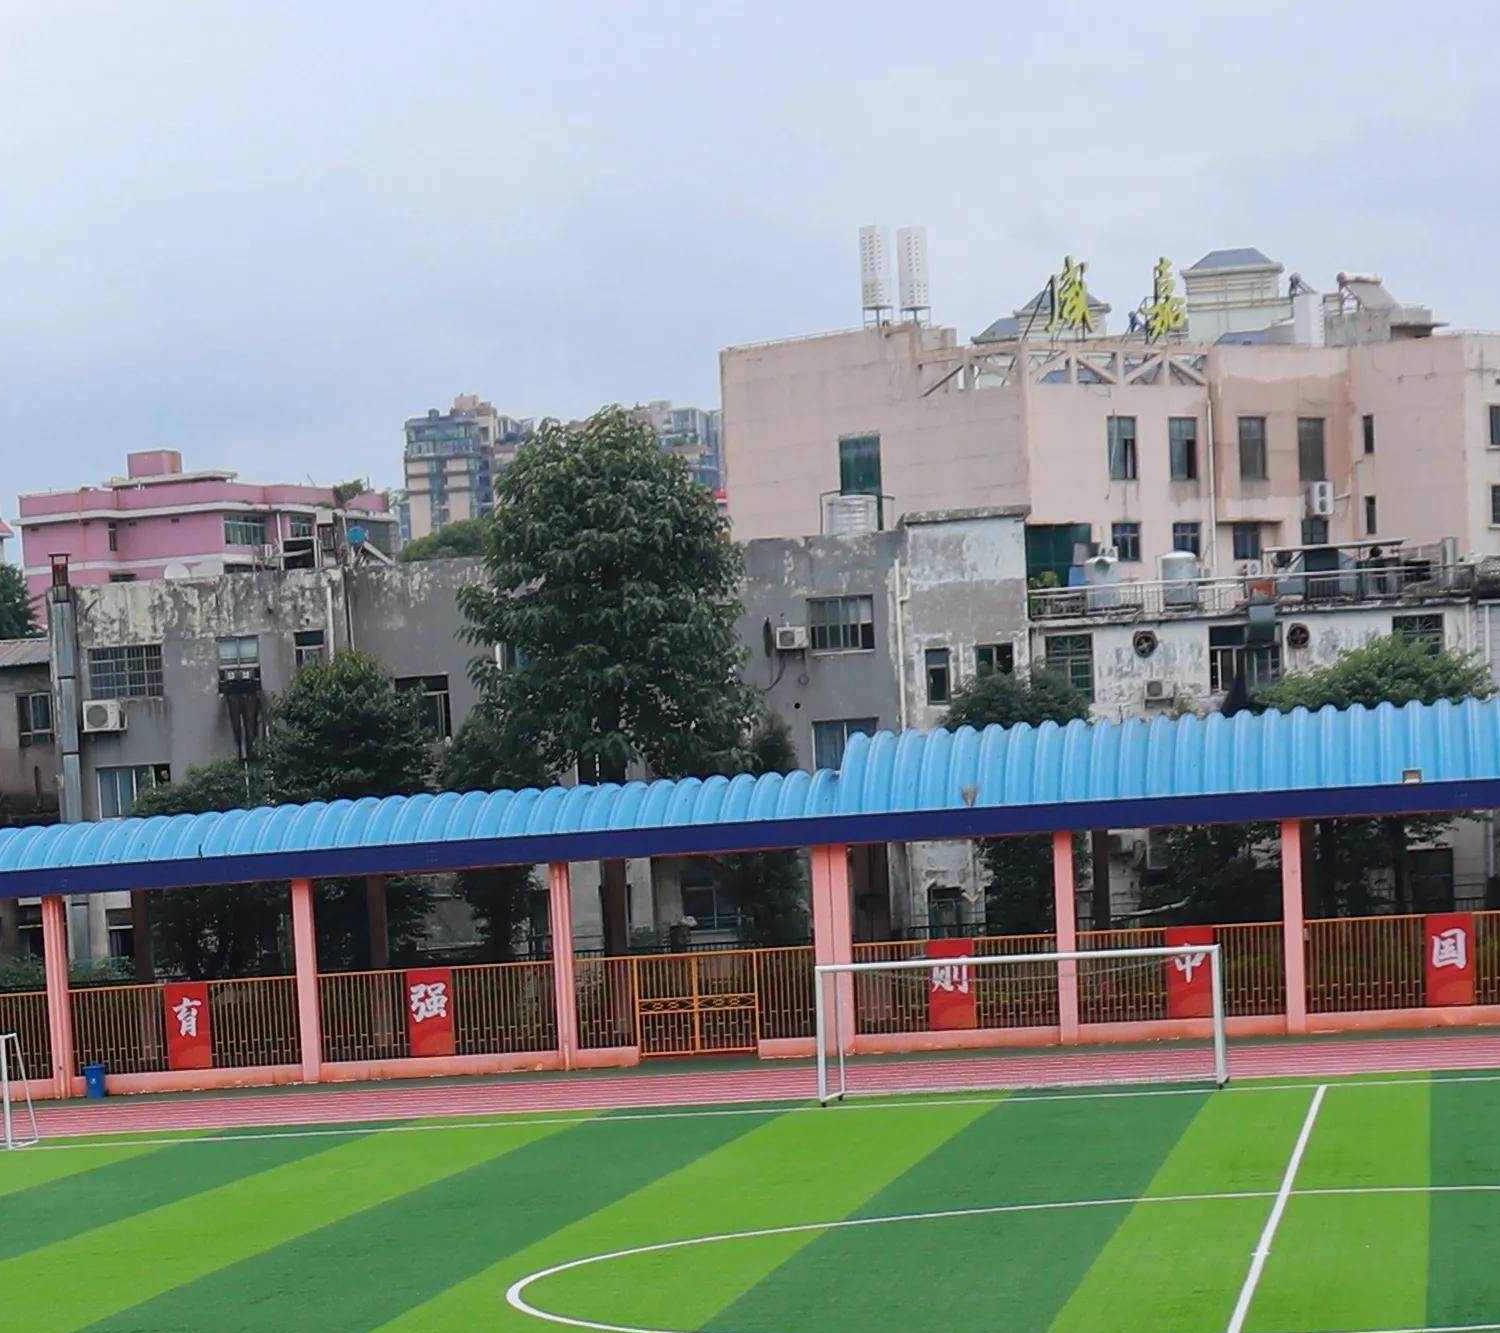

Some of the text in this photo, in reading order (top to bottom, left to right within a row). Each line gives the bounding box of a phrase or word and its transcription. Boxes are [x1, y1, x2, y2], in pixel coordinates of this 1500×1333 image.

[1175, 943, 1206, 983] 中
[1432, 928, 1468, 969] 国
[932, 955, 969, 993] 则
[172, 997, 202, 1037] 育
[410, 982, 448, 1023] 强
